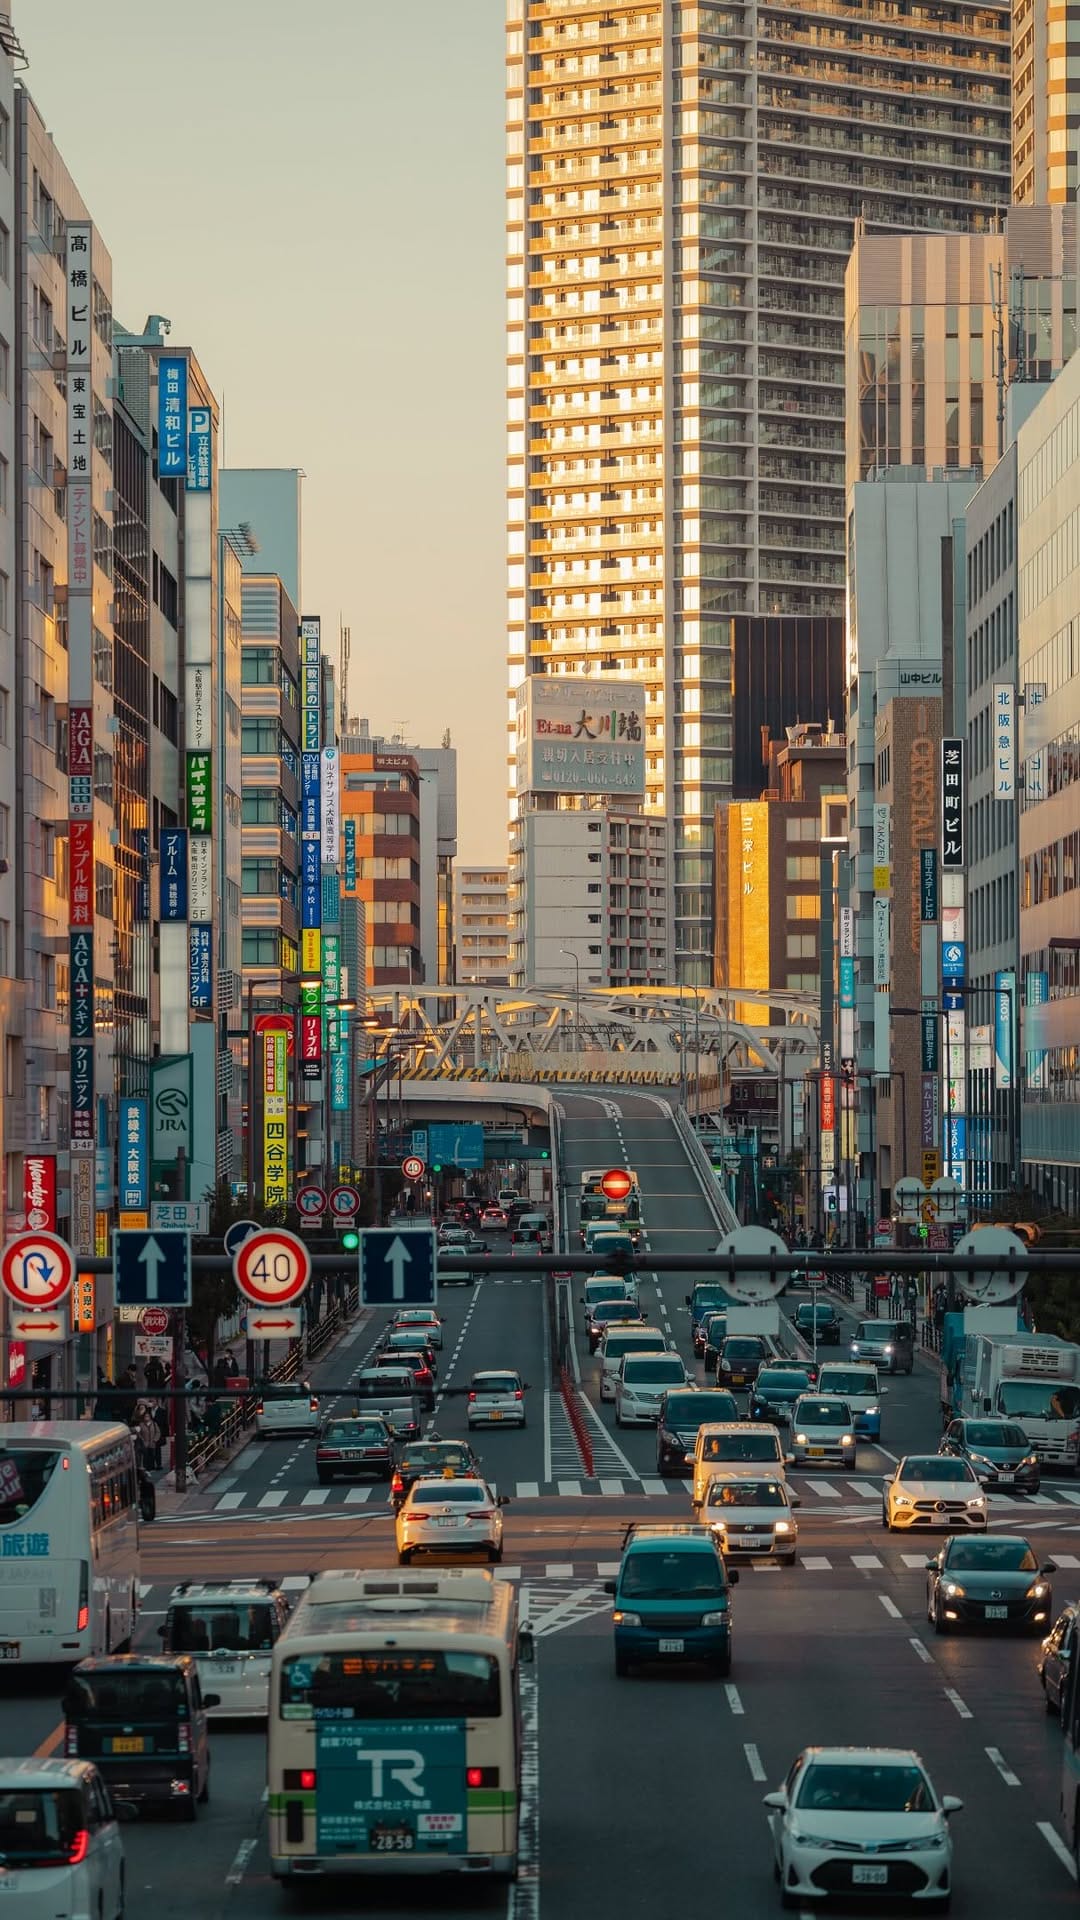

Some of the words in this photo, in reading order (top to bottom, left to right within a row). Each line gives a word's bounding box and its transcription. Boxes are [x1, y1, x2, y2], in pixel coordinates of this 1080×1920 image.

[70, 235, 88, 356] 髙橋ビル
[72, 377, 87, 471] 東宝土地
[165, 368, 181, 466] 梅田清和ビル
[73, 487, 88, 585] テナント募集中
[307, 638, 317, 748] 個別教室のトライ
[901, 673, 941, 684] 山中ビル
[76, 712, 91, 764] AGA
[302, 754, 319, 762] CIVI
[998, 692, 1011, 791] 北阪急ビル
[191, 756, 208, 831] バイオテック
[326, 763, 335, 863] ルネサンス大阪高等学校
[945, 750, 961, 855] 芝田町ビル
[73, 823, 90, 923] アップル歯科
[167, 834, 178, 876] ブルーム
[346, 825, 354, 887] マエダビル
[742, 817, 754, 895] 三栄ビル
[193, 909, 206, 919] 5F
[74, 934, 89, 982] AGA
[192, 996, 208, 1007] 5F
[306, 1019, 317, 1057] リーブ21
[335, 1057, 345, 1104] Z会の教室
[156, 1119, 187, 1132] JRA
[27, 1159, 48, 1207] Wendy's
[127, 1148, 140, 1184] 大阪校
[266, 1122, 284, 1203] 四谷学院
[408, 1162, 418, 1173] 40
[157, 1206, 186, 1220] 芝田
[251, 1254, 290, 1283] 40
[82, 1282, 93, 1320] 吉野家
[357, 1750, 425, 1798] TR
[377, 1835, 412, 1849] 28-58
